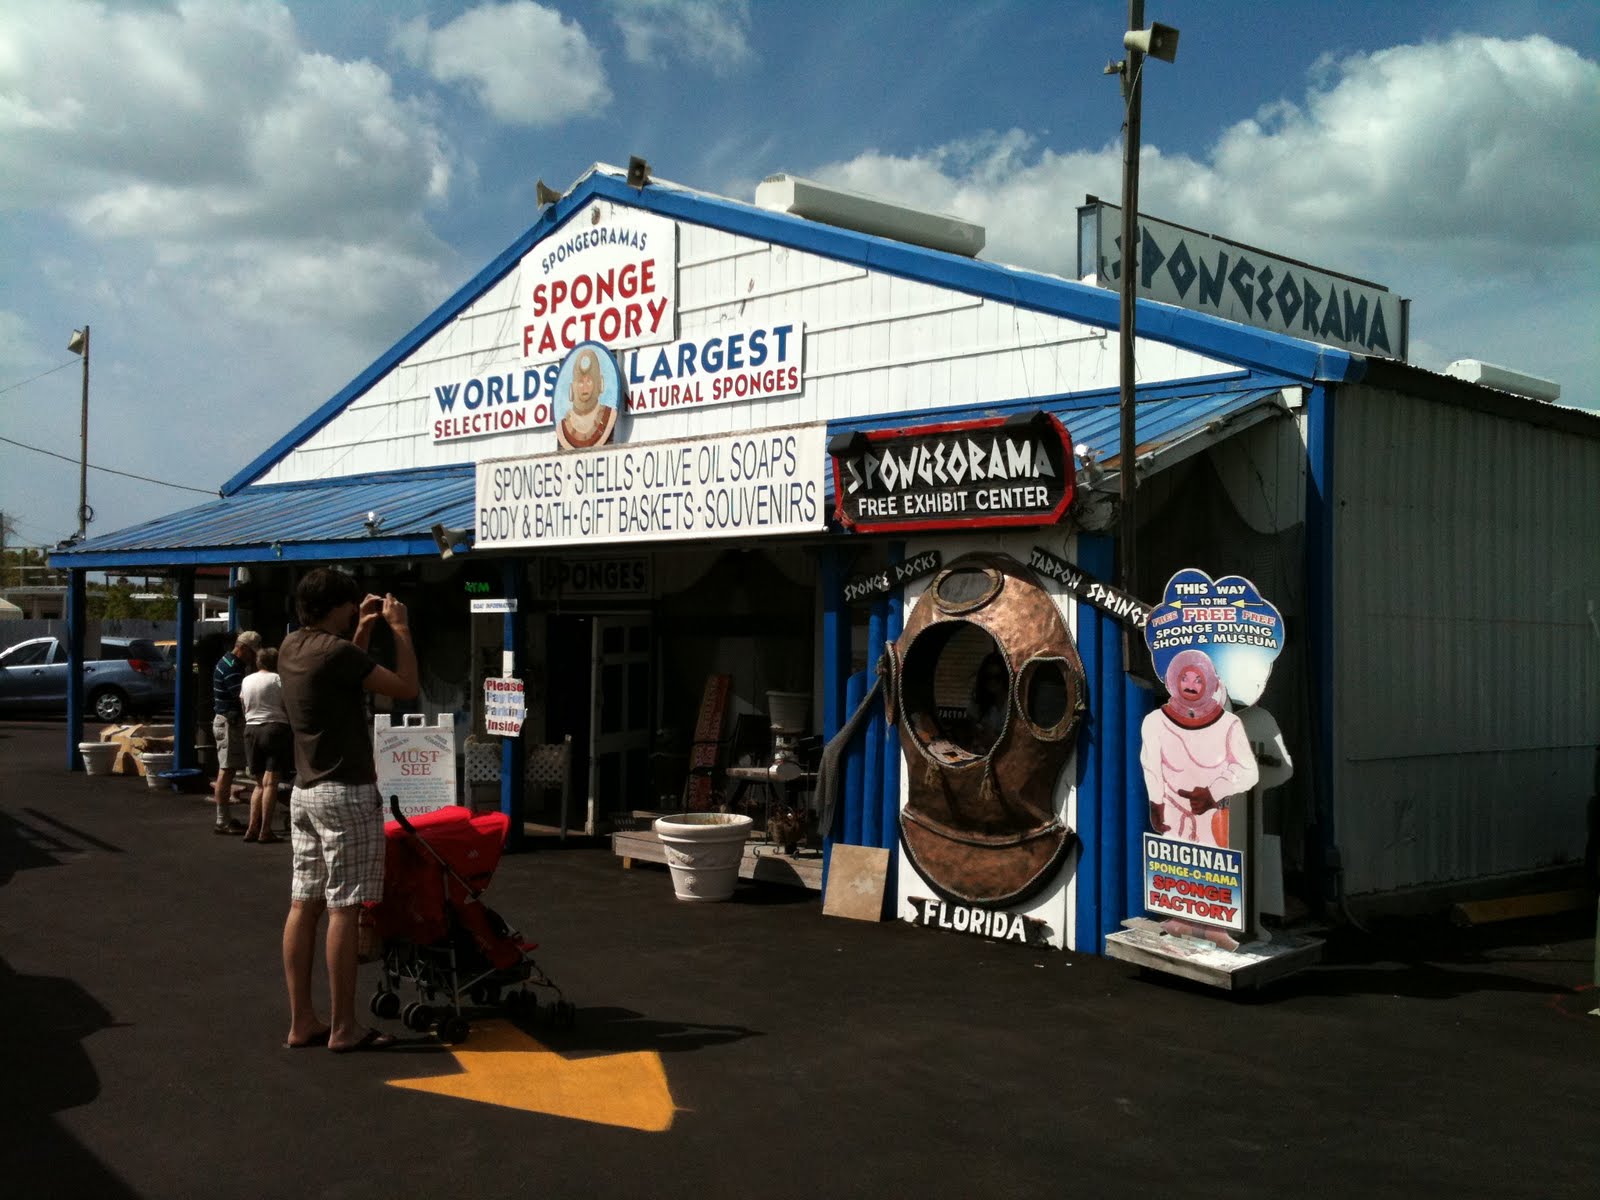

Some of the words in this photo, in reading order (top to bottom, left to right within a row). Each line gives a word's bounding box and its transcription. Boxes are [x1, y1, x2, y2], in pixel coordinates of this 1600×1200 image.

[542, 227, 647, 275] SPONGEORAMAS
[533, 258, 656, 317] SPONGE
[523, 297, 668, 357] FACTORY
[434, 365, 560, 413] WORLDS
[629, 324, 794, 384] LARGEST
[434, 408, 526, 439] SELECTION
[624, 382, 703, 412] NATURAL
[712, 366, 799, 401] SPONGES
[494, 462, 563, 502] SPONGES
[574, 454, 634, 495] SHELLS
[642, 448, 692, 489] OLIVE
[698, 445, 725, 485] OIL
[730, 436, 796, 481] SOAPS
[846, 437, 1056, 494] SPONGEORAMA
[480, 506, 518, 541] BODY
[522, 505, 532, 537] &
[535, 501, 571, 538] BATH
[580, 498, 614, 536] GIFT
[619, 491, 695, 533] BASKETS
[704, 480, 816, 529] SOUVENIRS
[858, 496, 898, 517] FREE
[904, 491, 968, 515] EXHIBIT
[975, 486, 1050, 510] CENTER
[844, 573, 889, 601] SPONGE
[895, 552, 937, 580] DOCKS
[1030, 551, 1082, 590] TARPON
[1086, 583, 1149, 628] SPRINGS
[1175, 583, 1208, 595] THIS
[1216, 585, 1246, 595] WAY
[1152, 611, 1178, 627] FREE
[1183, 607, 1237, 622] FREE
[1242, 610, 1276, 627] FREE
[1156, 623, 1213, 639] SPONGE
[1217, 623, 1273, 636] DIVING
[1153, 635, 1193, 650] SHOW
[1197, 635, 1208, 644] &
[1213, 634, 1278, 649] MUSEUM
[486, 680, 525, 692] Please
[488, 719, 520, 732] Inside
[392, 750, 440, 763] MUST
[401, 764, 431, 776] SEE
[384, 806, 432, 814] BOME
[1147, 840, 1239, 873] ORIGINAL
[1149, 861, 1238, 887] SPONGE-O-RAMA
[1153, 874, 1232, 904] SPONGE
[923, 900, 1027, 943] FLORIDA
[1149, 891, 1238, 922] FACTORY
